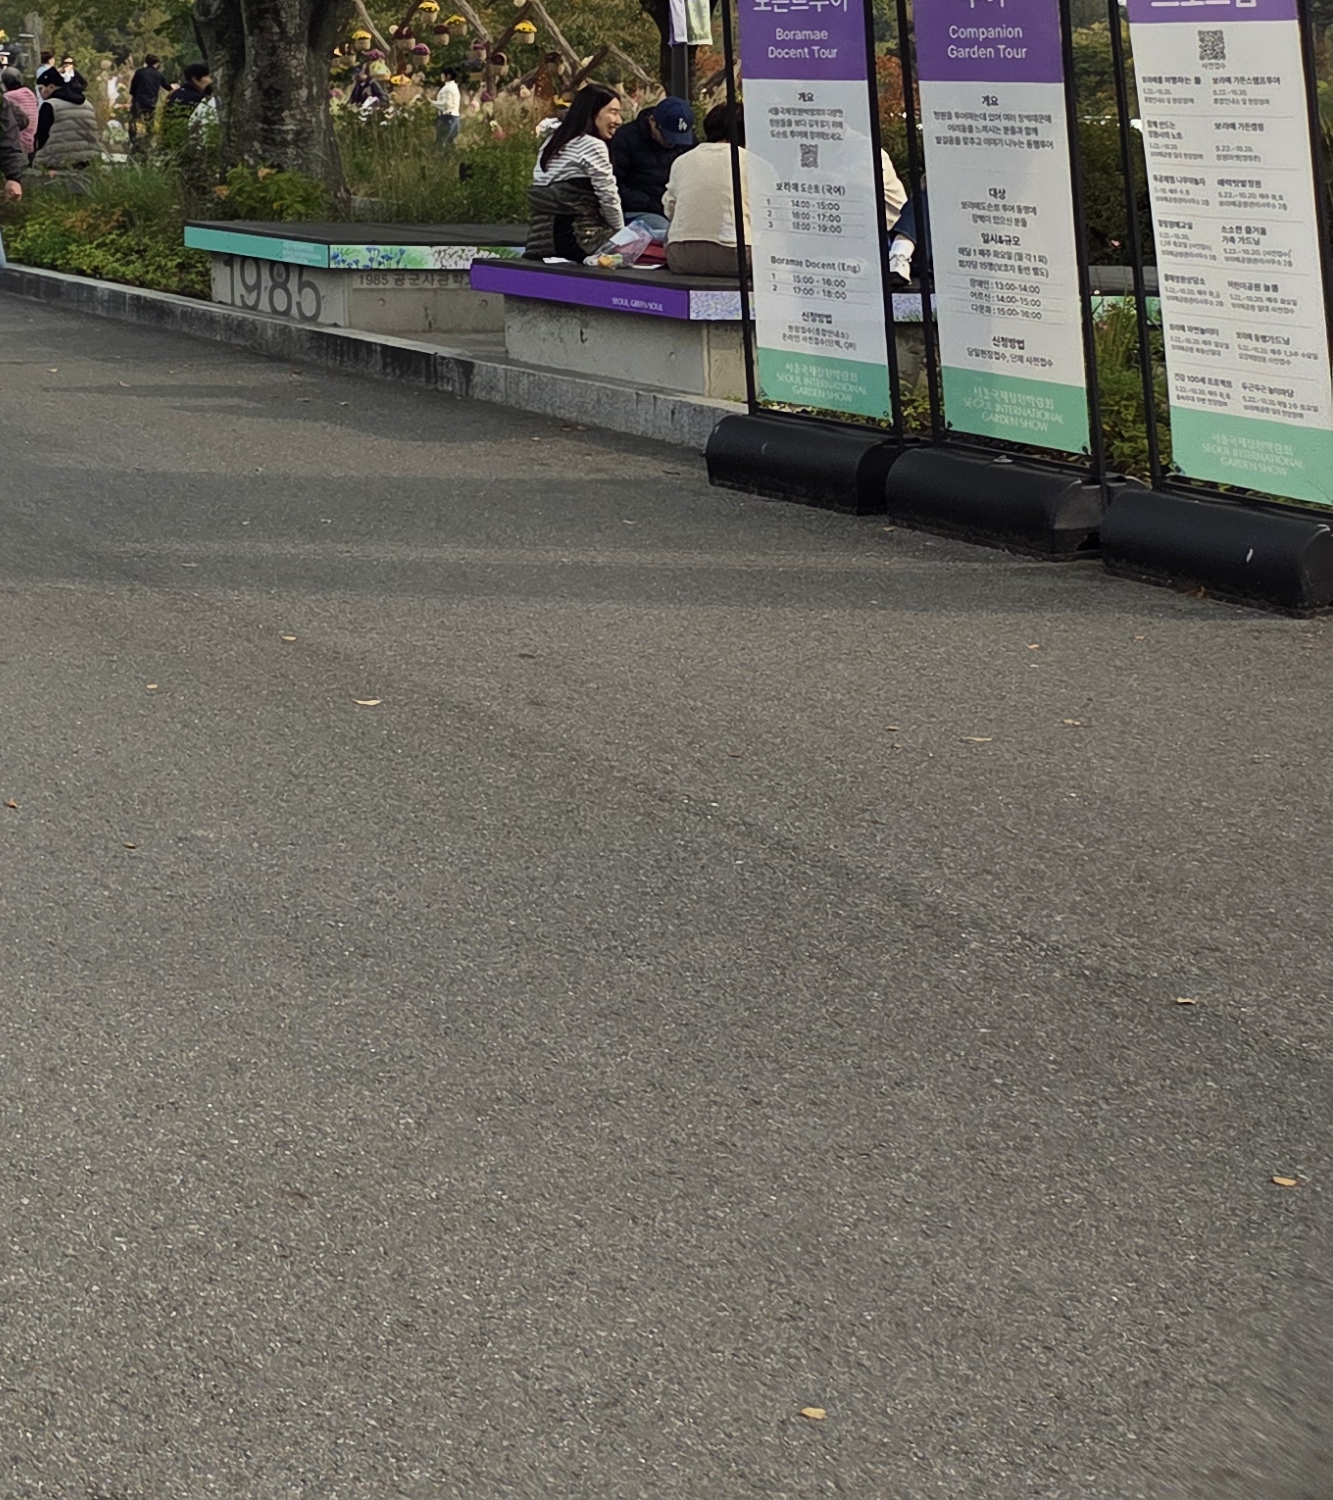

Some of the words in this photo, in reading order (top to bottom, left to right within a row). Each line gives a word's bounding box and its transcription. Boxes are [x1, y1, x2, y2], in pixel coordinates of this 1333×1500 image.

[776, 28, 828, 40] Boramae
[949, 24, 1022, 42] Companion
[768, 46, 809, 58] Docent
[811, 46, 837, 58] Tour
[947, 45, 994, 58] Garden
[997, 45, 1027, 58] Tour
[798, 92, 815, 102] 개요
[981, 95, 999, 106] 개요
[988, 188, 1006, 199] 대상
[981, 232, 1021, 246] 일시&규모
[771, 256, 803, 268] Boramae
[805, 259, 836, 270] Docent
[838, 262, 861, 273] (Eng)
[357, 273, 389, 287] 1985
[393, 273, 471, 287] 공군사관학
[222, 256, 322, 322] 1985
